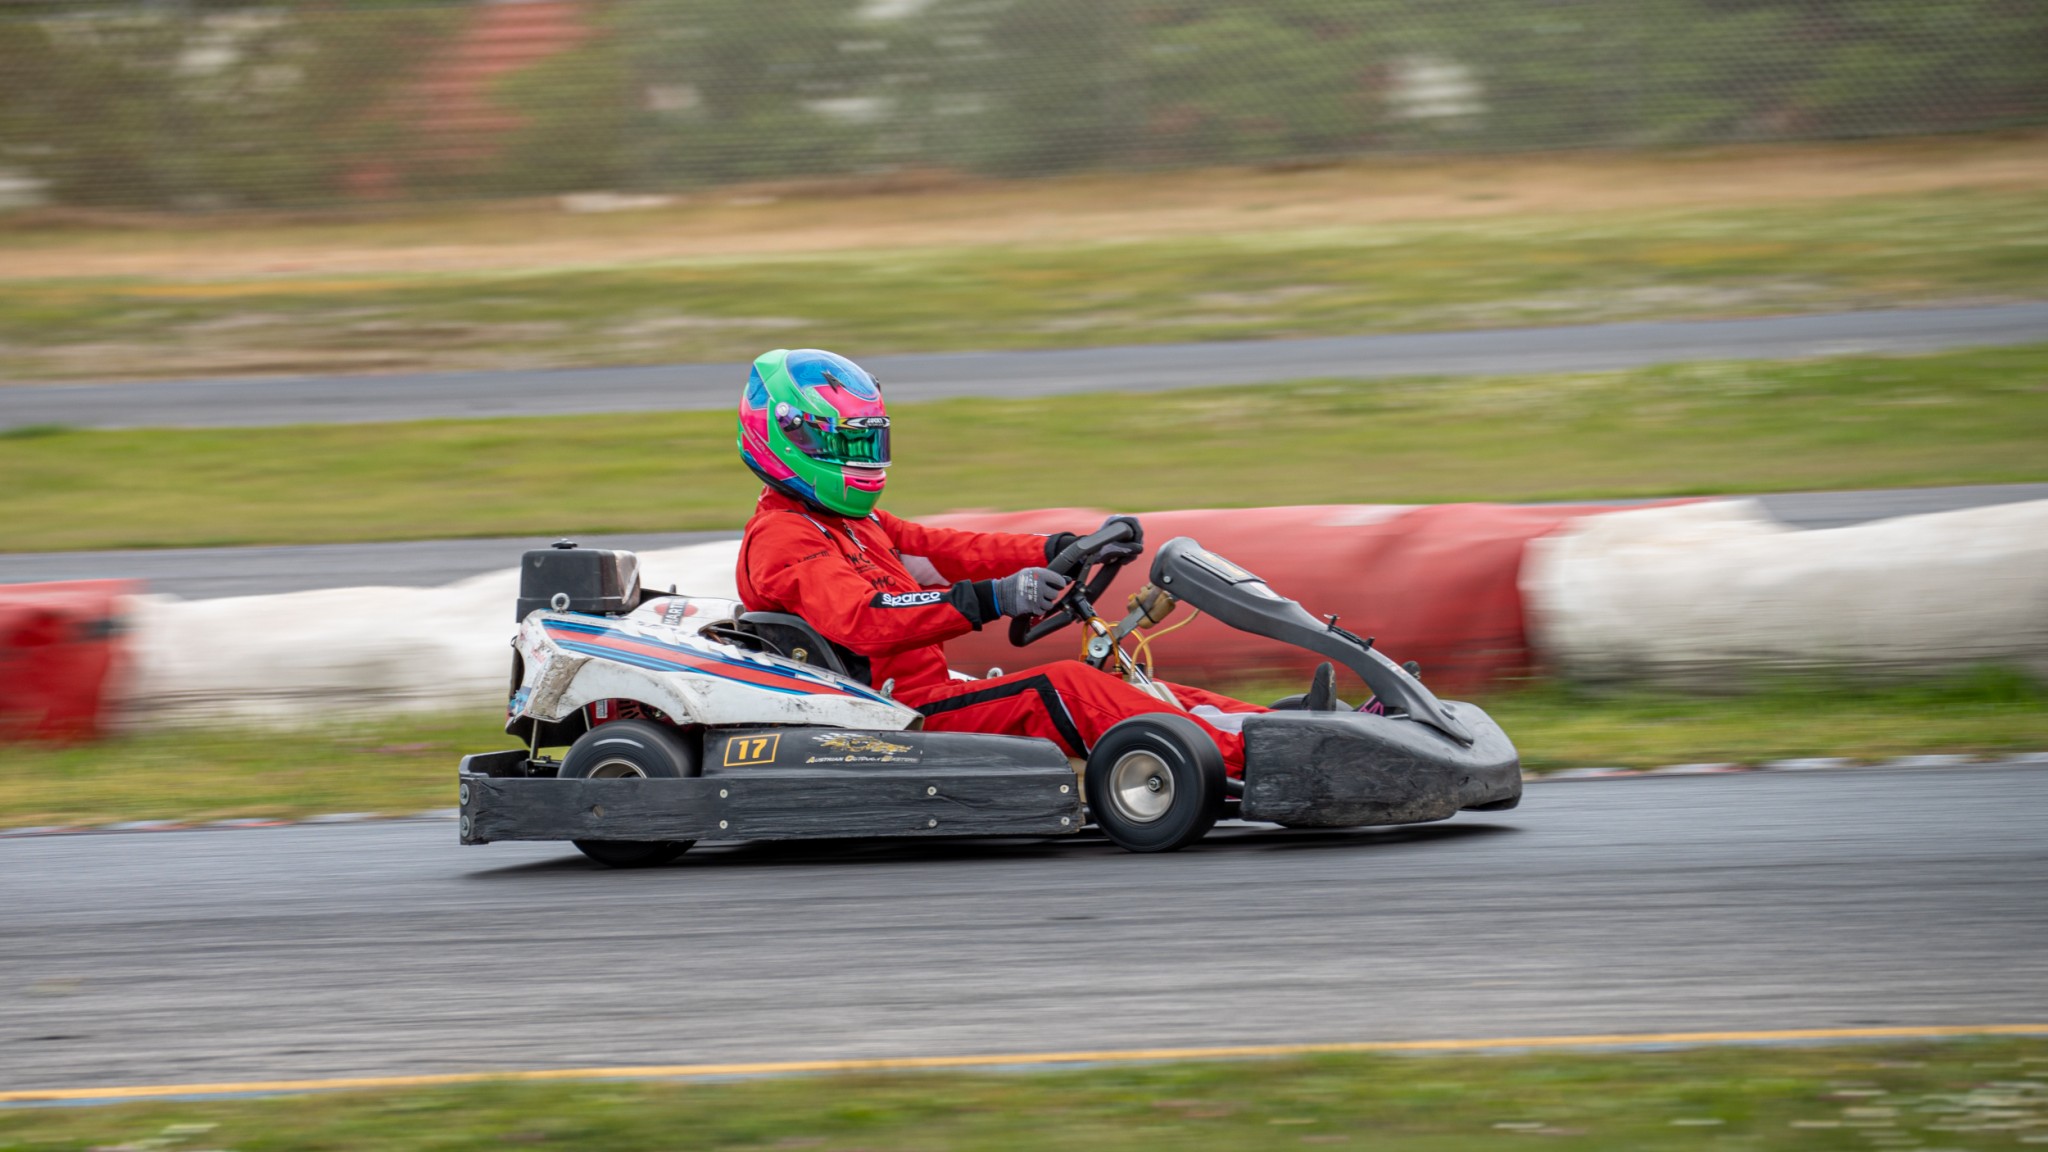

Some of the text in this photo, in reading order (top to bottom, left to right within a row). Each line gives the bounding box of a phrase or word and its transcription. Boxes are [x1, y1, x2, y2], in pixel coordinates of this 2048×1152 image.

[881, 591, 941, 607] Sparco
[663, 600, 685, 625] MARTI
[738, 738, 768, 760] 17
